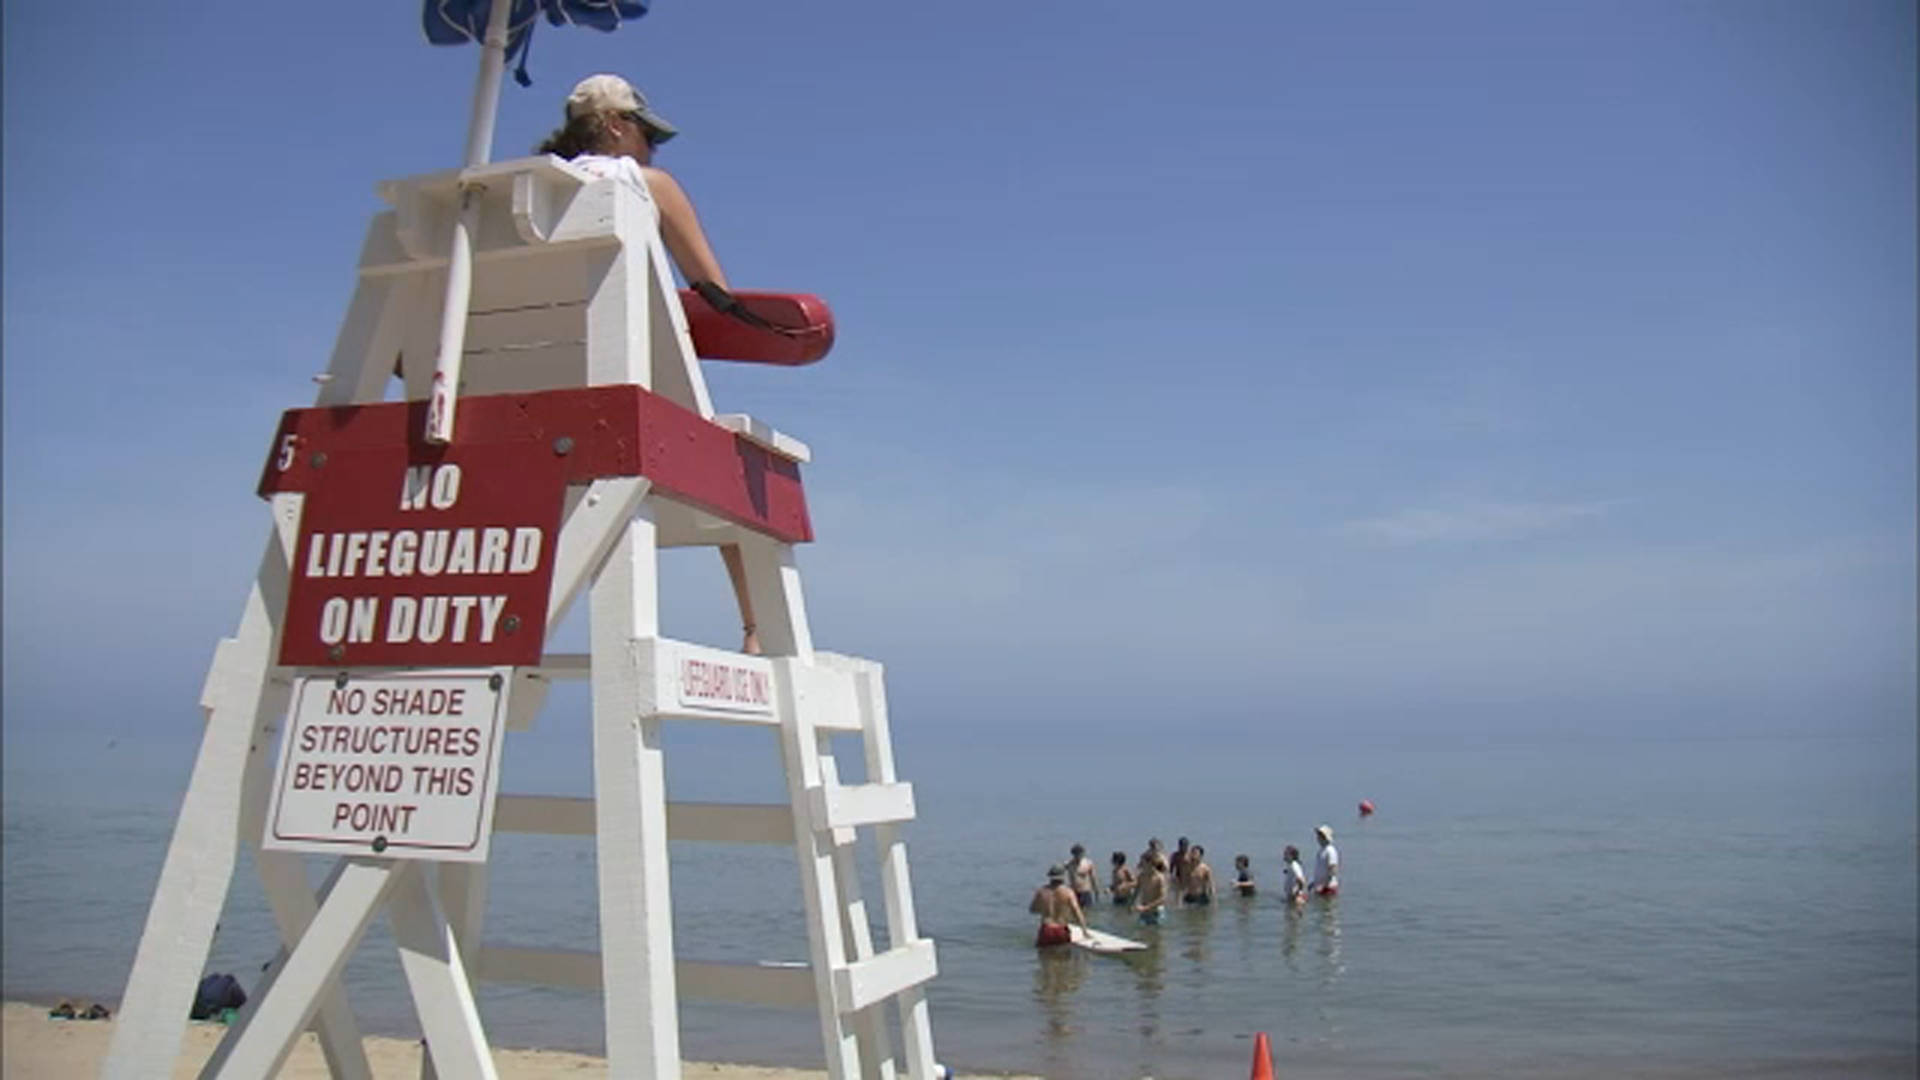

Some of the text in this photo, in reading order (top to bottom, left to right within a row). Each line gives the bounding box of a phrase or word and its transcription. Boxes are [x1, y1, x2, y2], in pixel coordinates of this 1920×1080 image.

[277, 433, 299, 472] 5
[400, 463, 462, 511] NO
[305, 526, 544, 578] LIFEGUARD
[319, 595, 508, 645] ON DUTY
[326, 688, 467, 716] NO SHADE
[299, 724, 482, 757] STRUCTURES
[293, 763, 476, 797] BEYOND THIS
[332, 802, 418, 834] POINT
